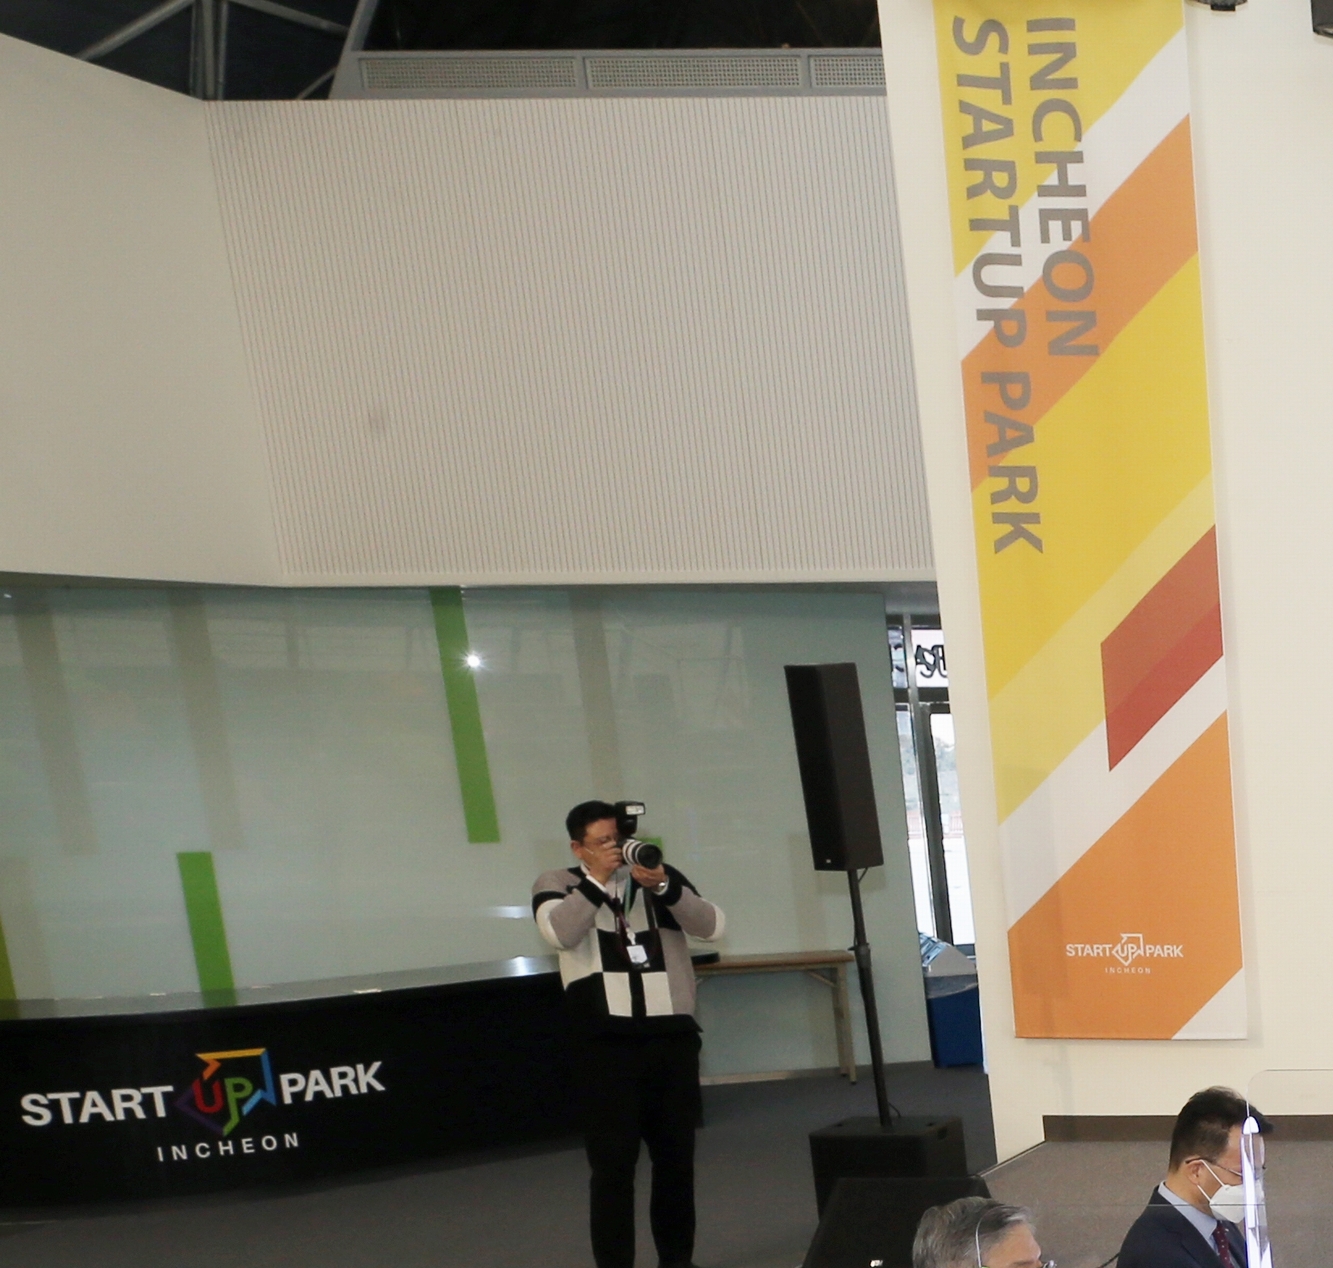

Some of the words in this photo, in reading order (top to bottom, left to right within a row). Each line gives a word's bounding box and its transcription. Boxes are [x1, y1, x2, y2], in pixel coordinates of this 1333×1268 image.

[952, 15, 1027, 348] STARTUP
[1026, 17, 1101, 357] INCHEON
[980, 371, 1044, 555] PARK
[1066, 943, 1112, 957] START
[1146, 945, 1183, 958] PARK
[1105, 966, 1151, 974] INCHEON
[20, 1085, 174, 1127] START
[279, 1060, 386, 1105] PARK
[156, 1131, 300, 1163] INCHEON
